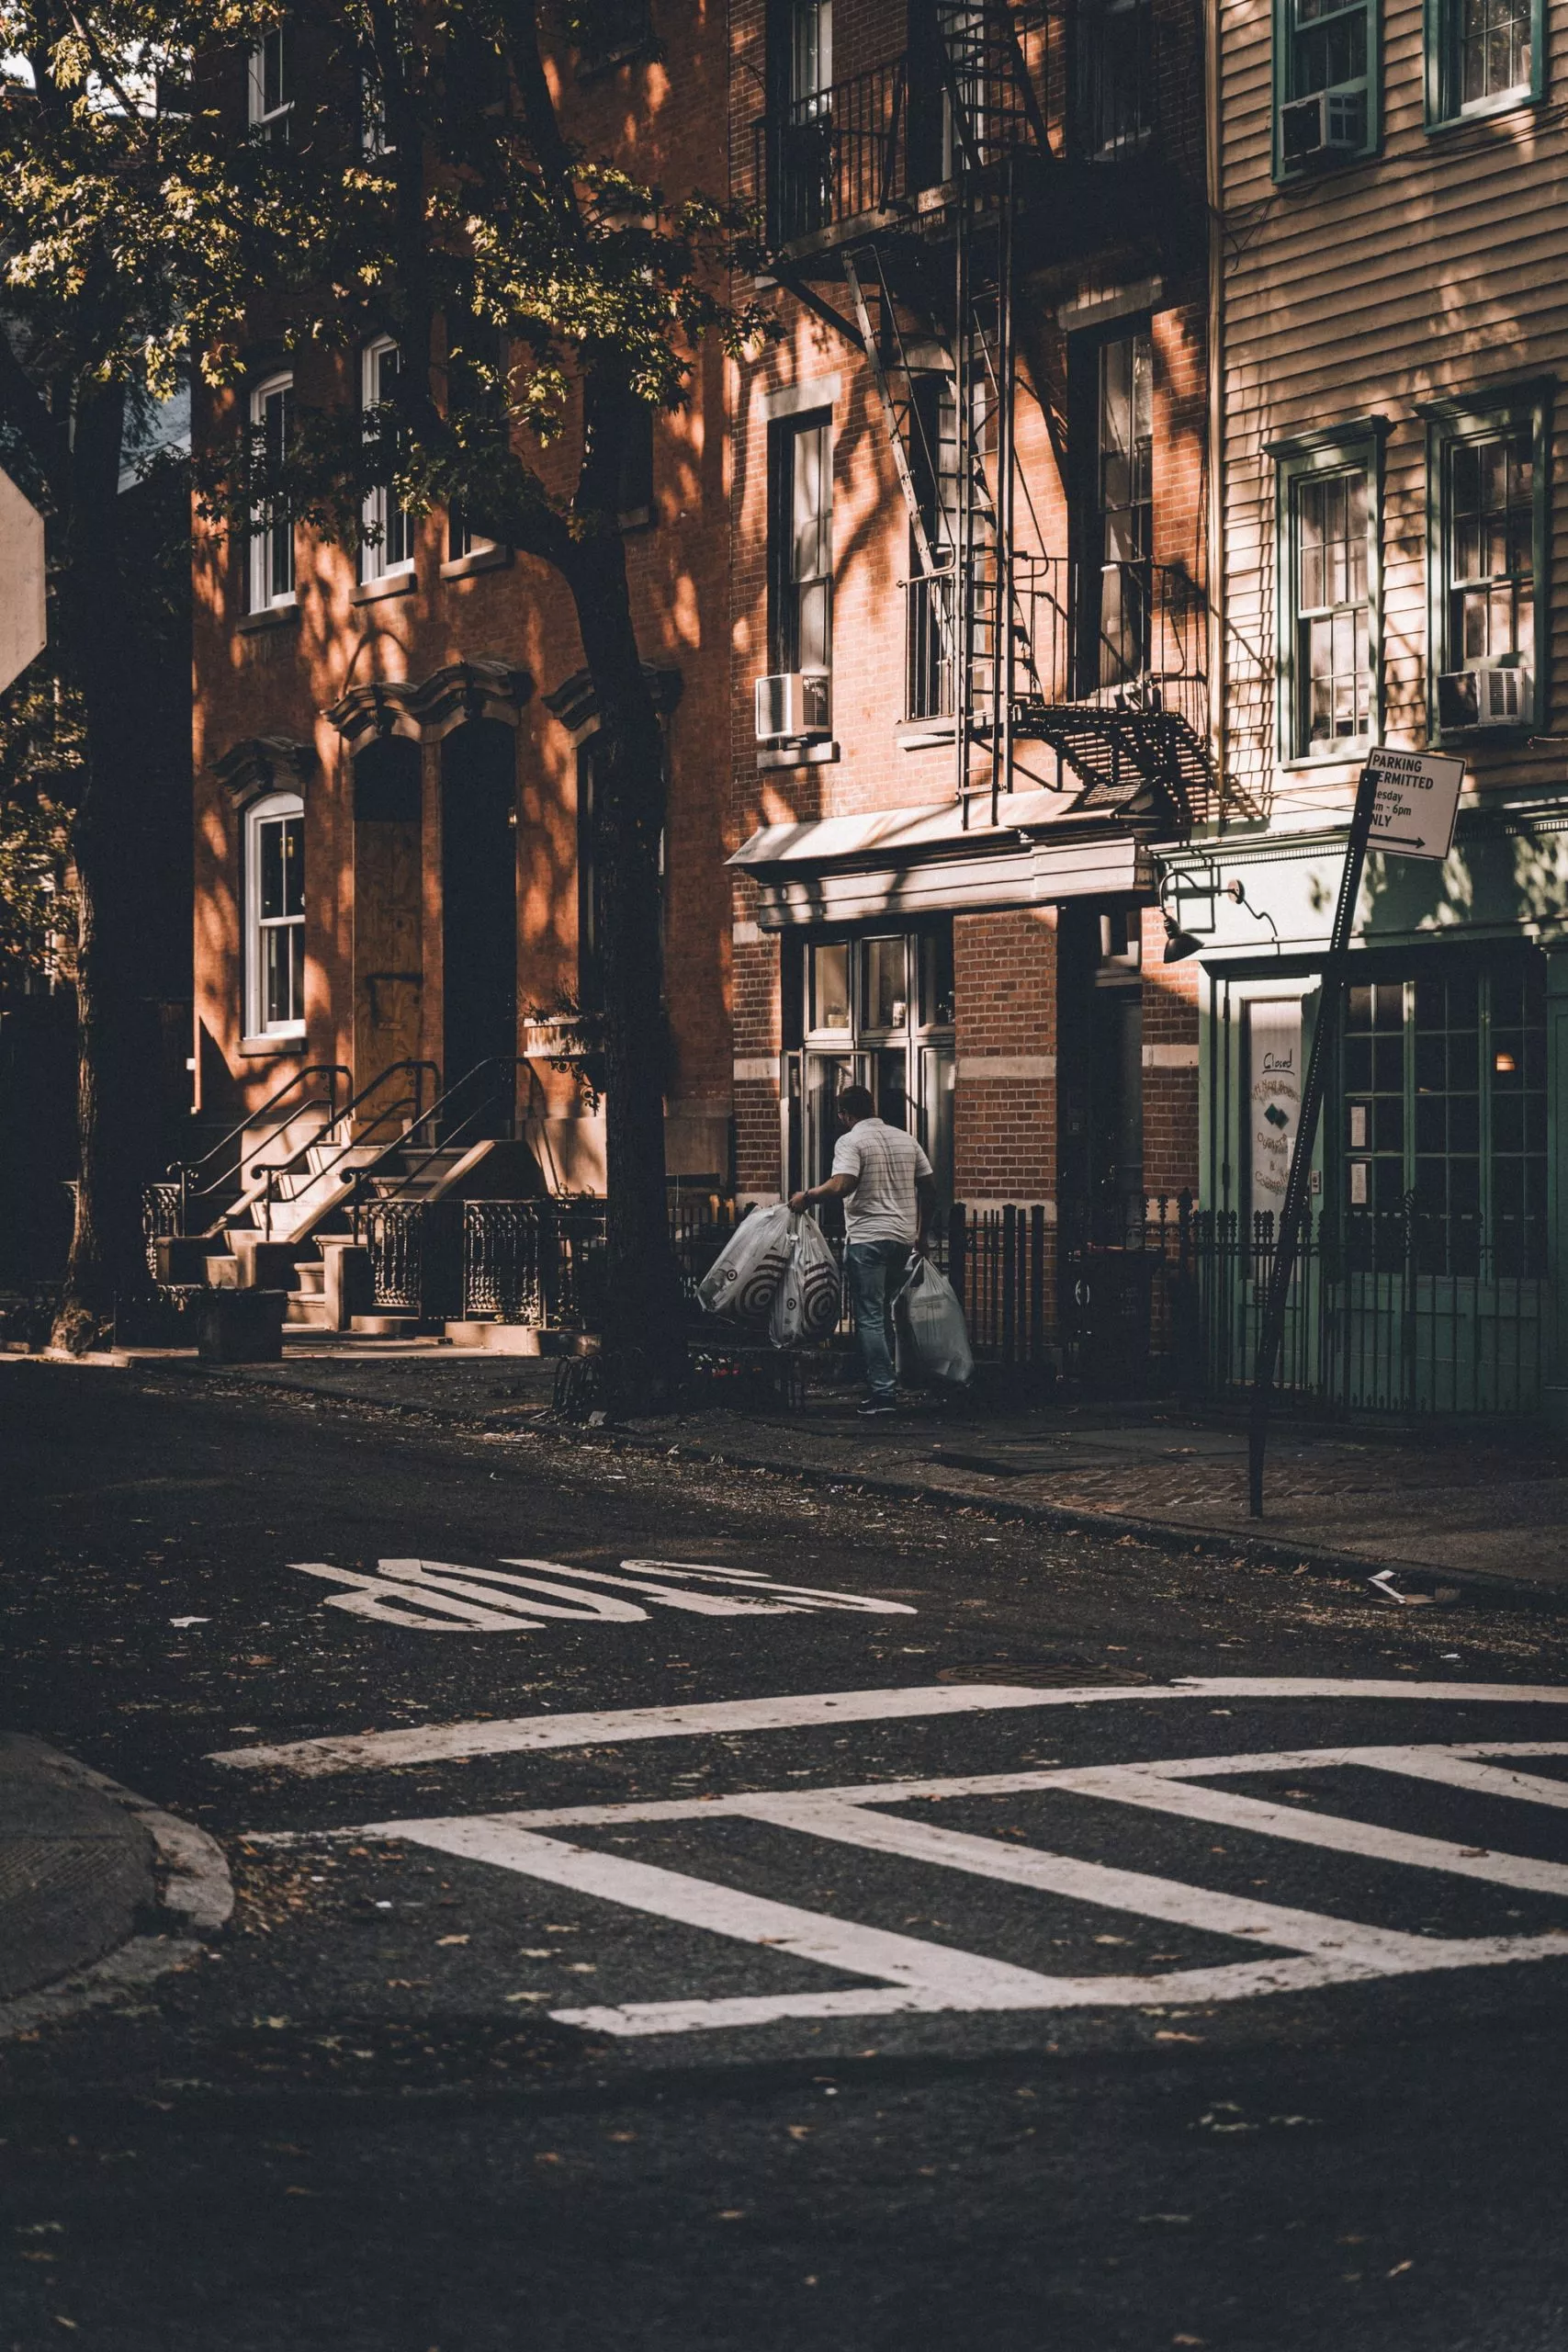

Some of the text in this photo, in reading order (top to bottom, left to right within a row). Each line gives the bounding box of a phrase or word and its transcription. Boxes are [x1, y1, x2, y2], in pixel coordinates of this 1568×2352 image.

[1372, 754, 1422, 773] PARKING
[1378, 771, 1434, 790] ERMITTED
[1376, 790, 1404, 804] esday
[1393, 803, 1412, 817] 6pm
[1371, 813, 1392, 828] NLY
[1264, 1048, 1292, 1069] Closed
[288, 1558, 919, 1632] STOP
